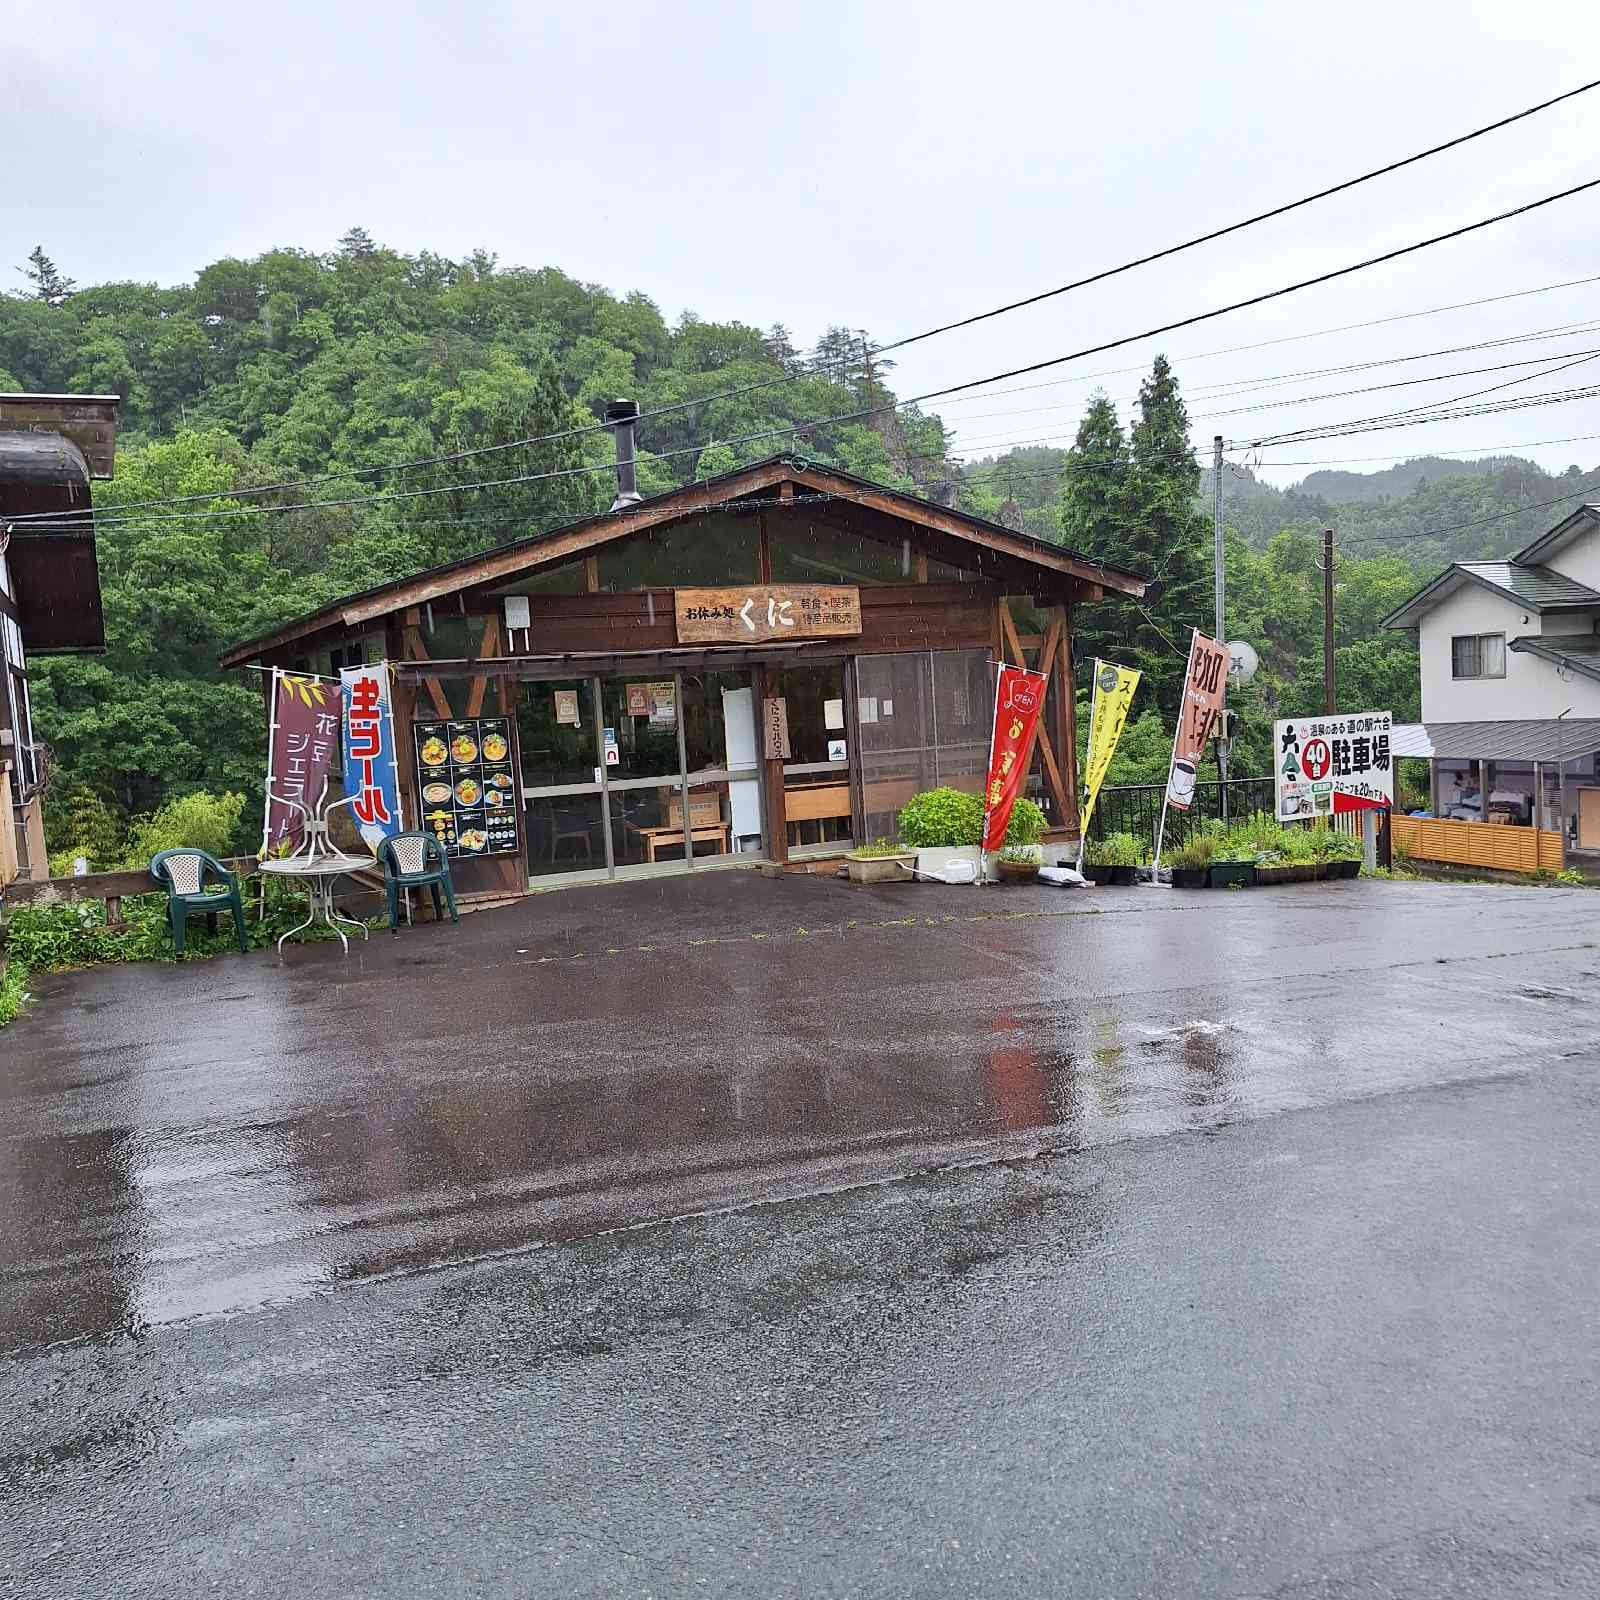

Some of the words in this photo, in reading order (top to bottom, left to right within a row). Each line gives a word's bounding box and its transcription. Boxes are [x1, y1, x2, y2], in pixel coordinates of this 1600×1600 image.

[686, 607, 735, 620] お休み処
[740, 597, 795, 631] くに
[1310, 723, 1346, 737] 温泉のある
[1347, 716, 1391, 734] 道の駅六合
[1306, 742, 1326, 763] 40
[1332, 735, 1391, 777] 駐車場
